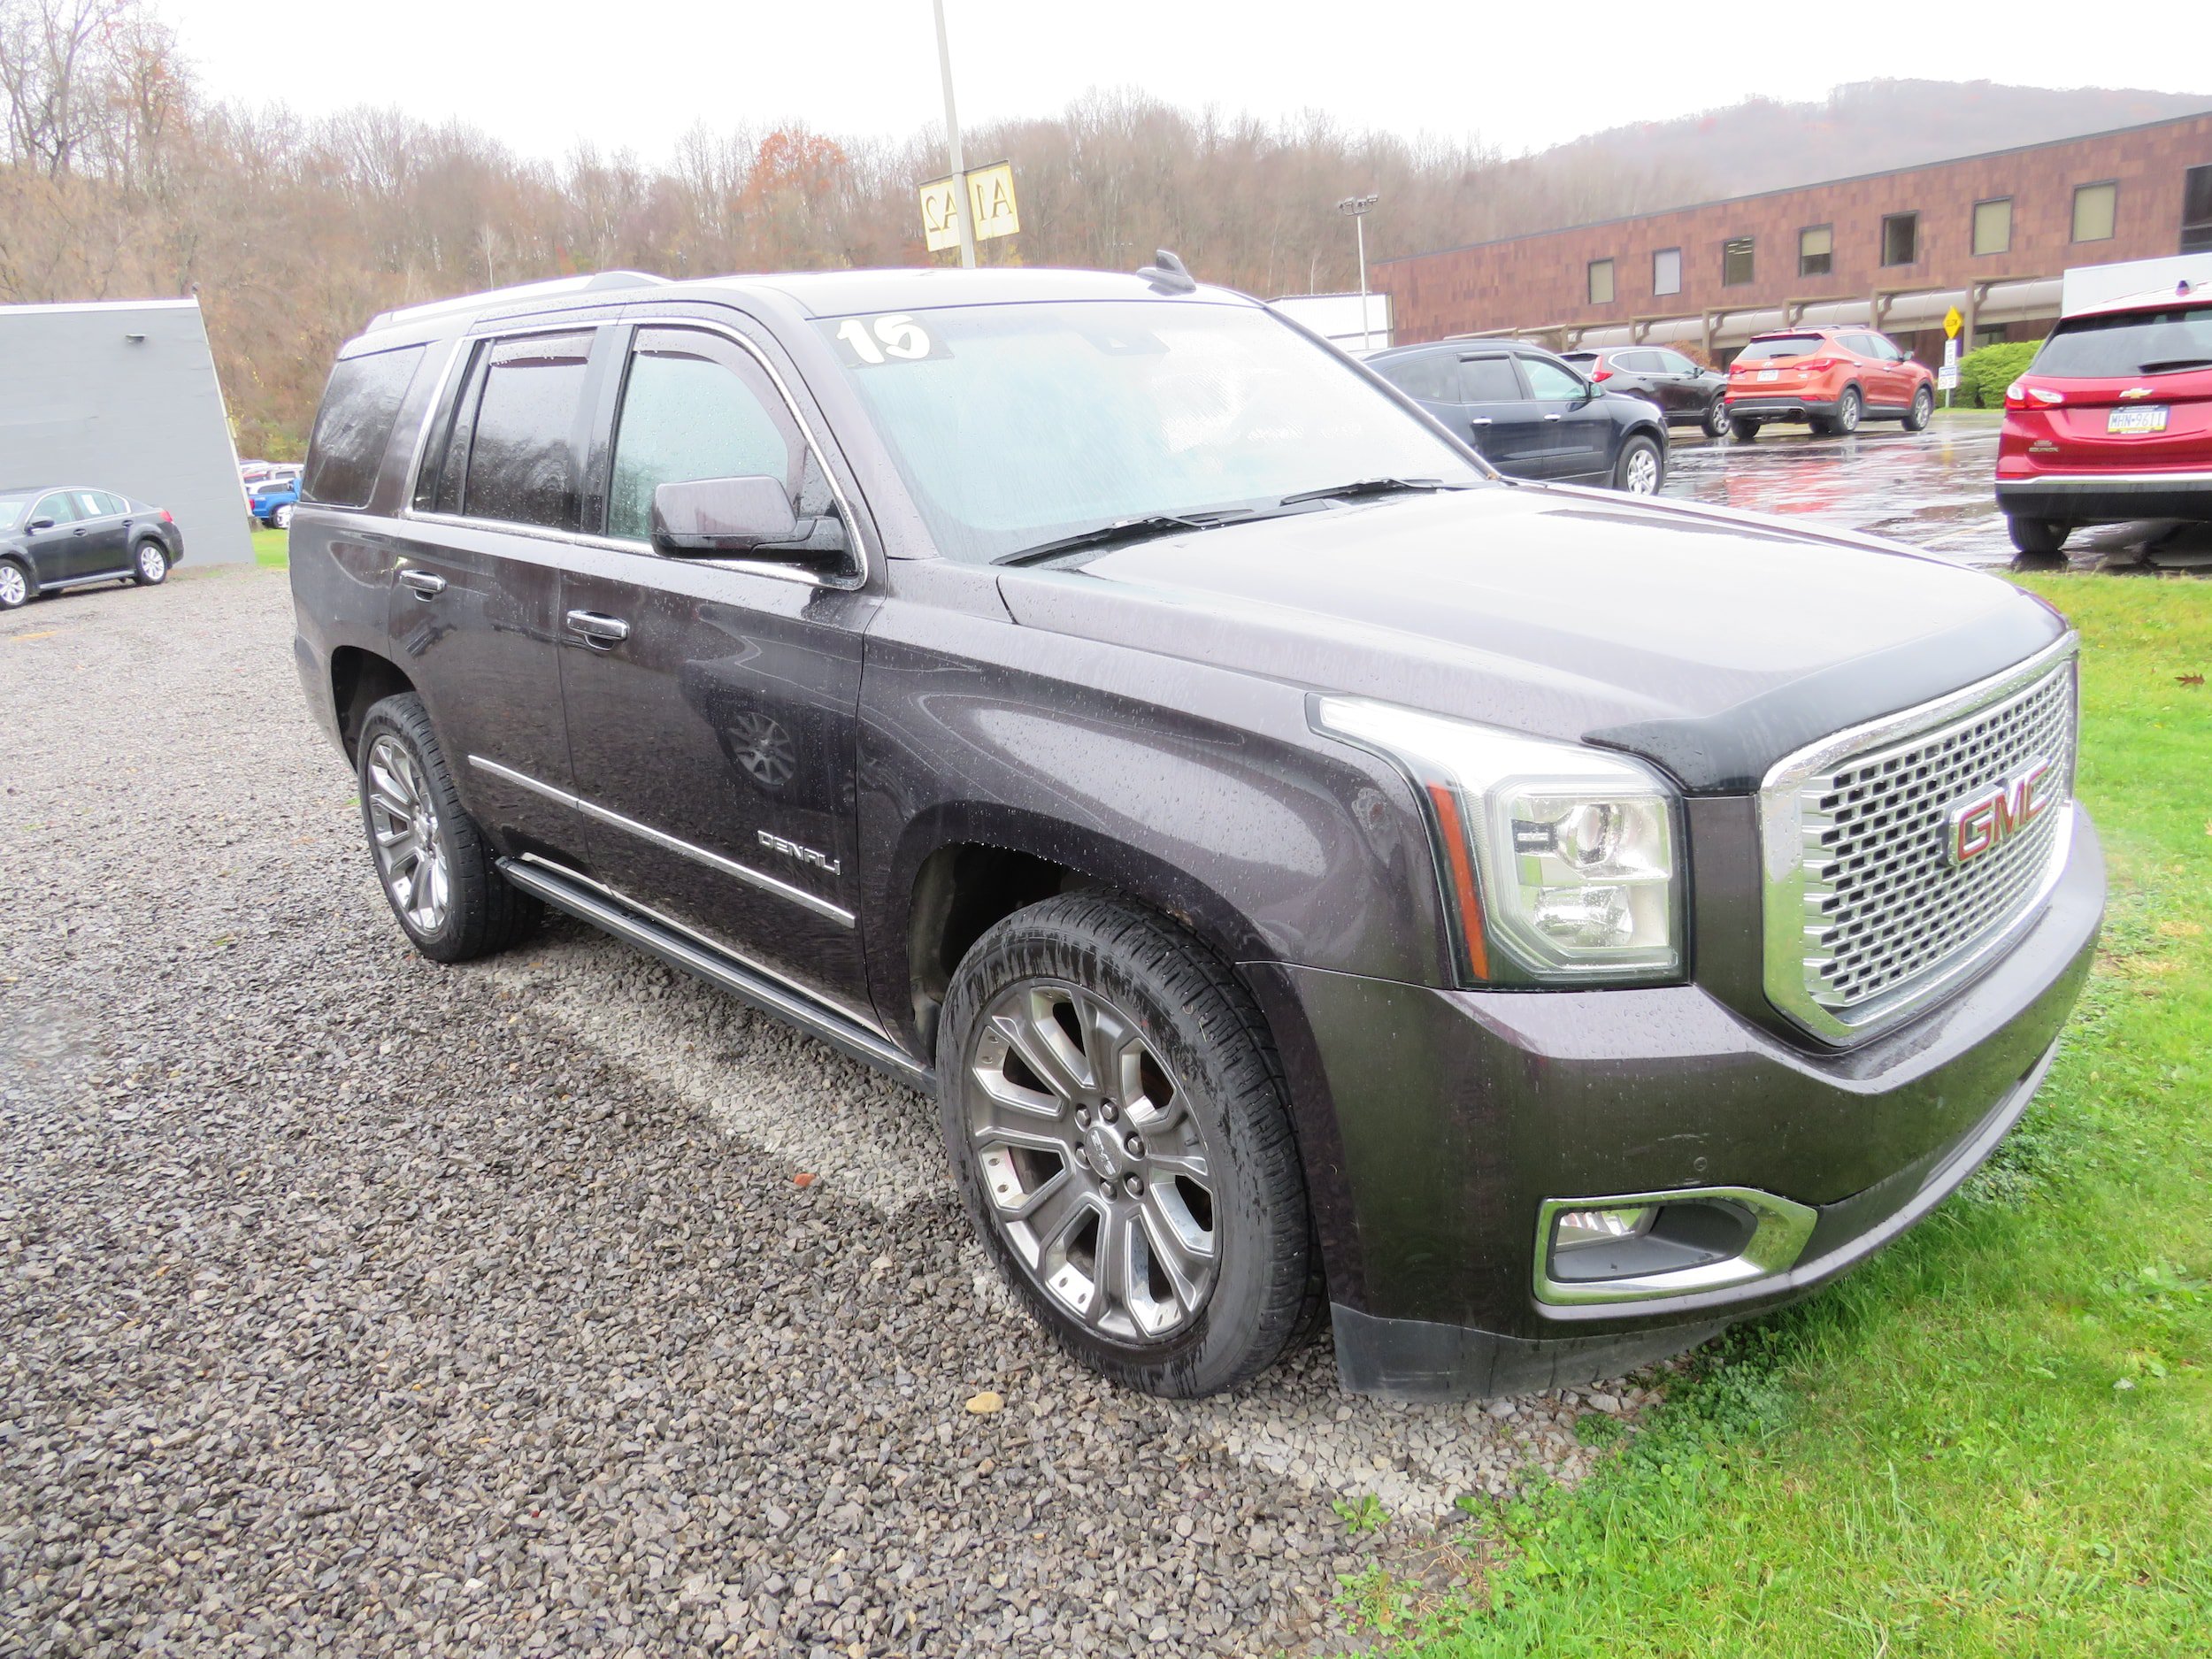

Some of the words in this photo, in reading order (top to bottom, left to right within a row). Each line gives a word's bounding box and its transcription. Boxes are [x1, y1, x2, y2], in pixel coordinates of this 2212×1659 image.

[835, 314, 931, 364] 15
[1948, 760, 2051, 865] GMC
[757, 830, 841, 876] DENALI
